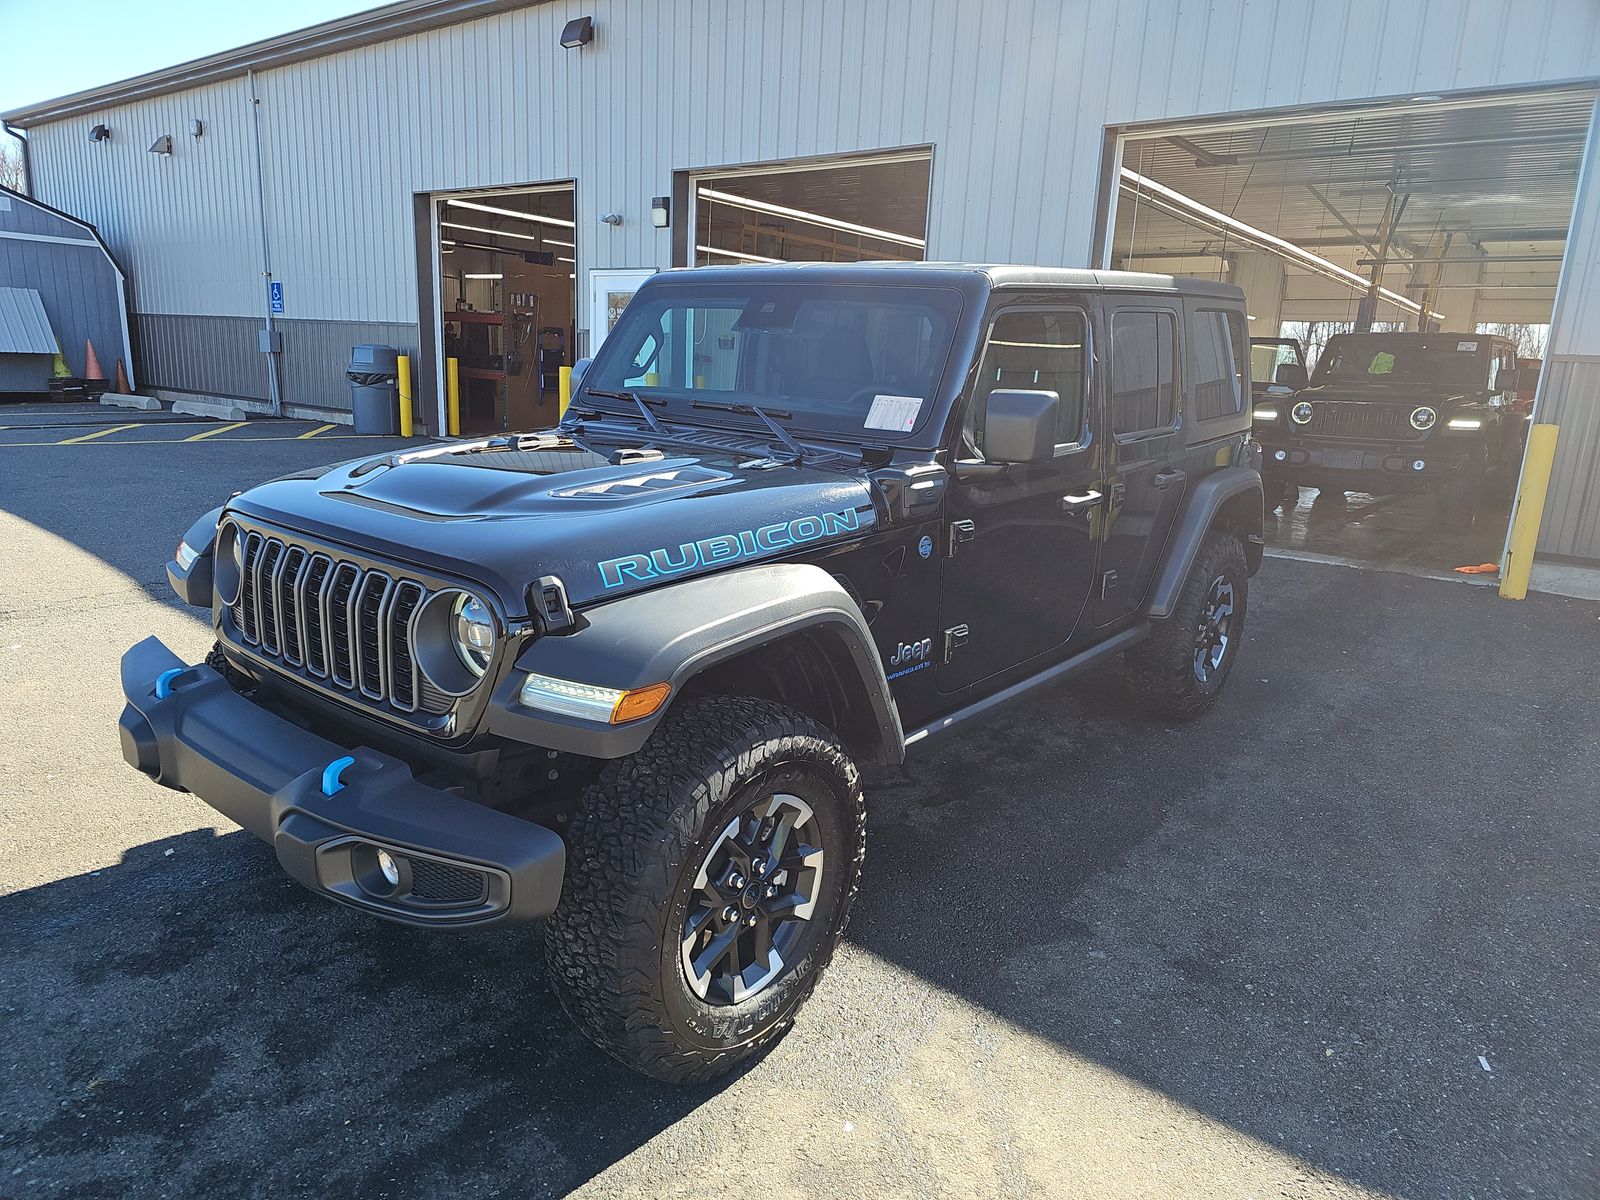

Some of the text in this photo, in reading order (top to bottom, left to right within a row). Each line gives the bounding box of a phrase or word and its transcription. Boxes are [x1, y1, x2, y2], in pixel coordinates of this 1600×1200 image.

[598, 507, 859, 588] RUBICON
[890, 638, 932, 666] Jeep
[886, 663, 924, 680] WRANGLER
